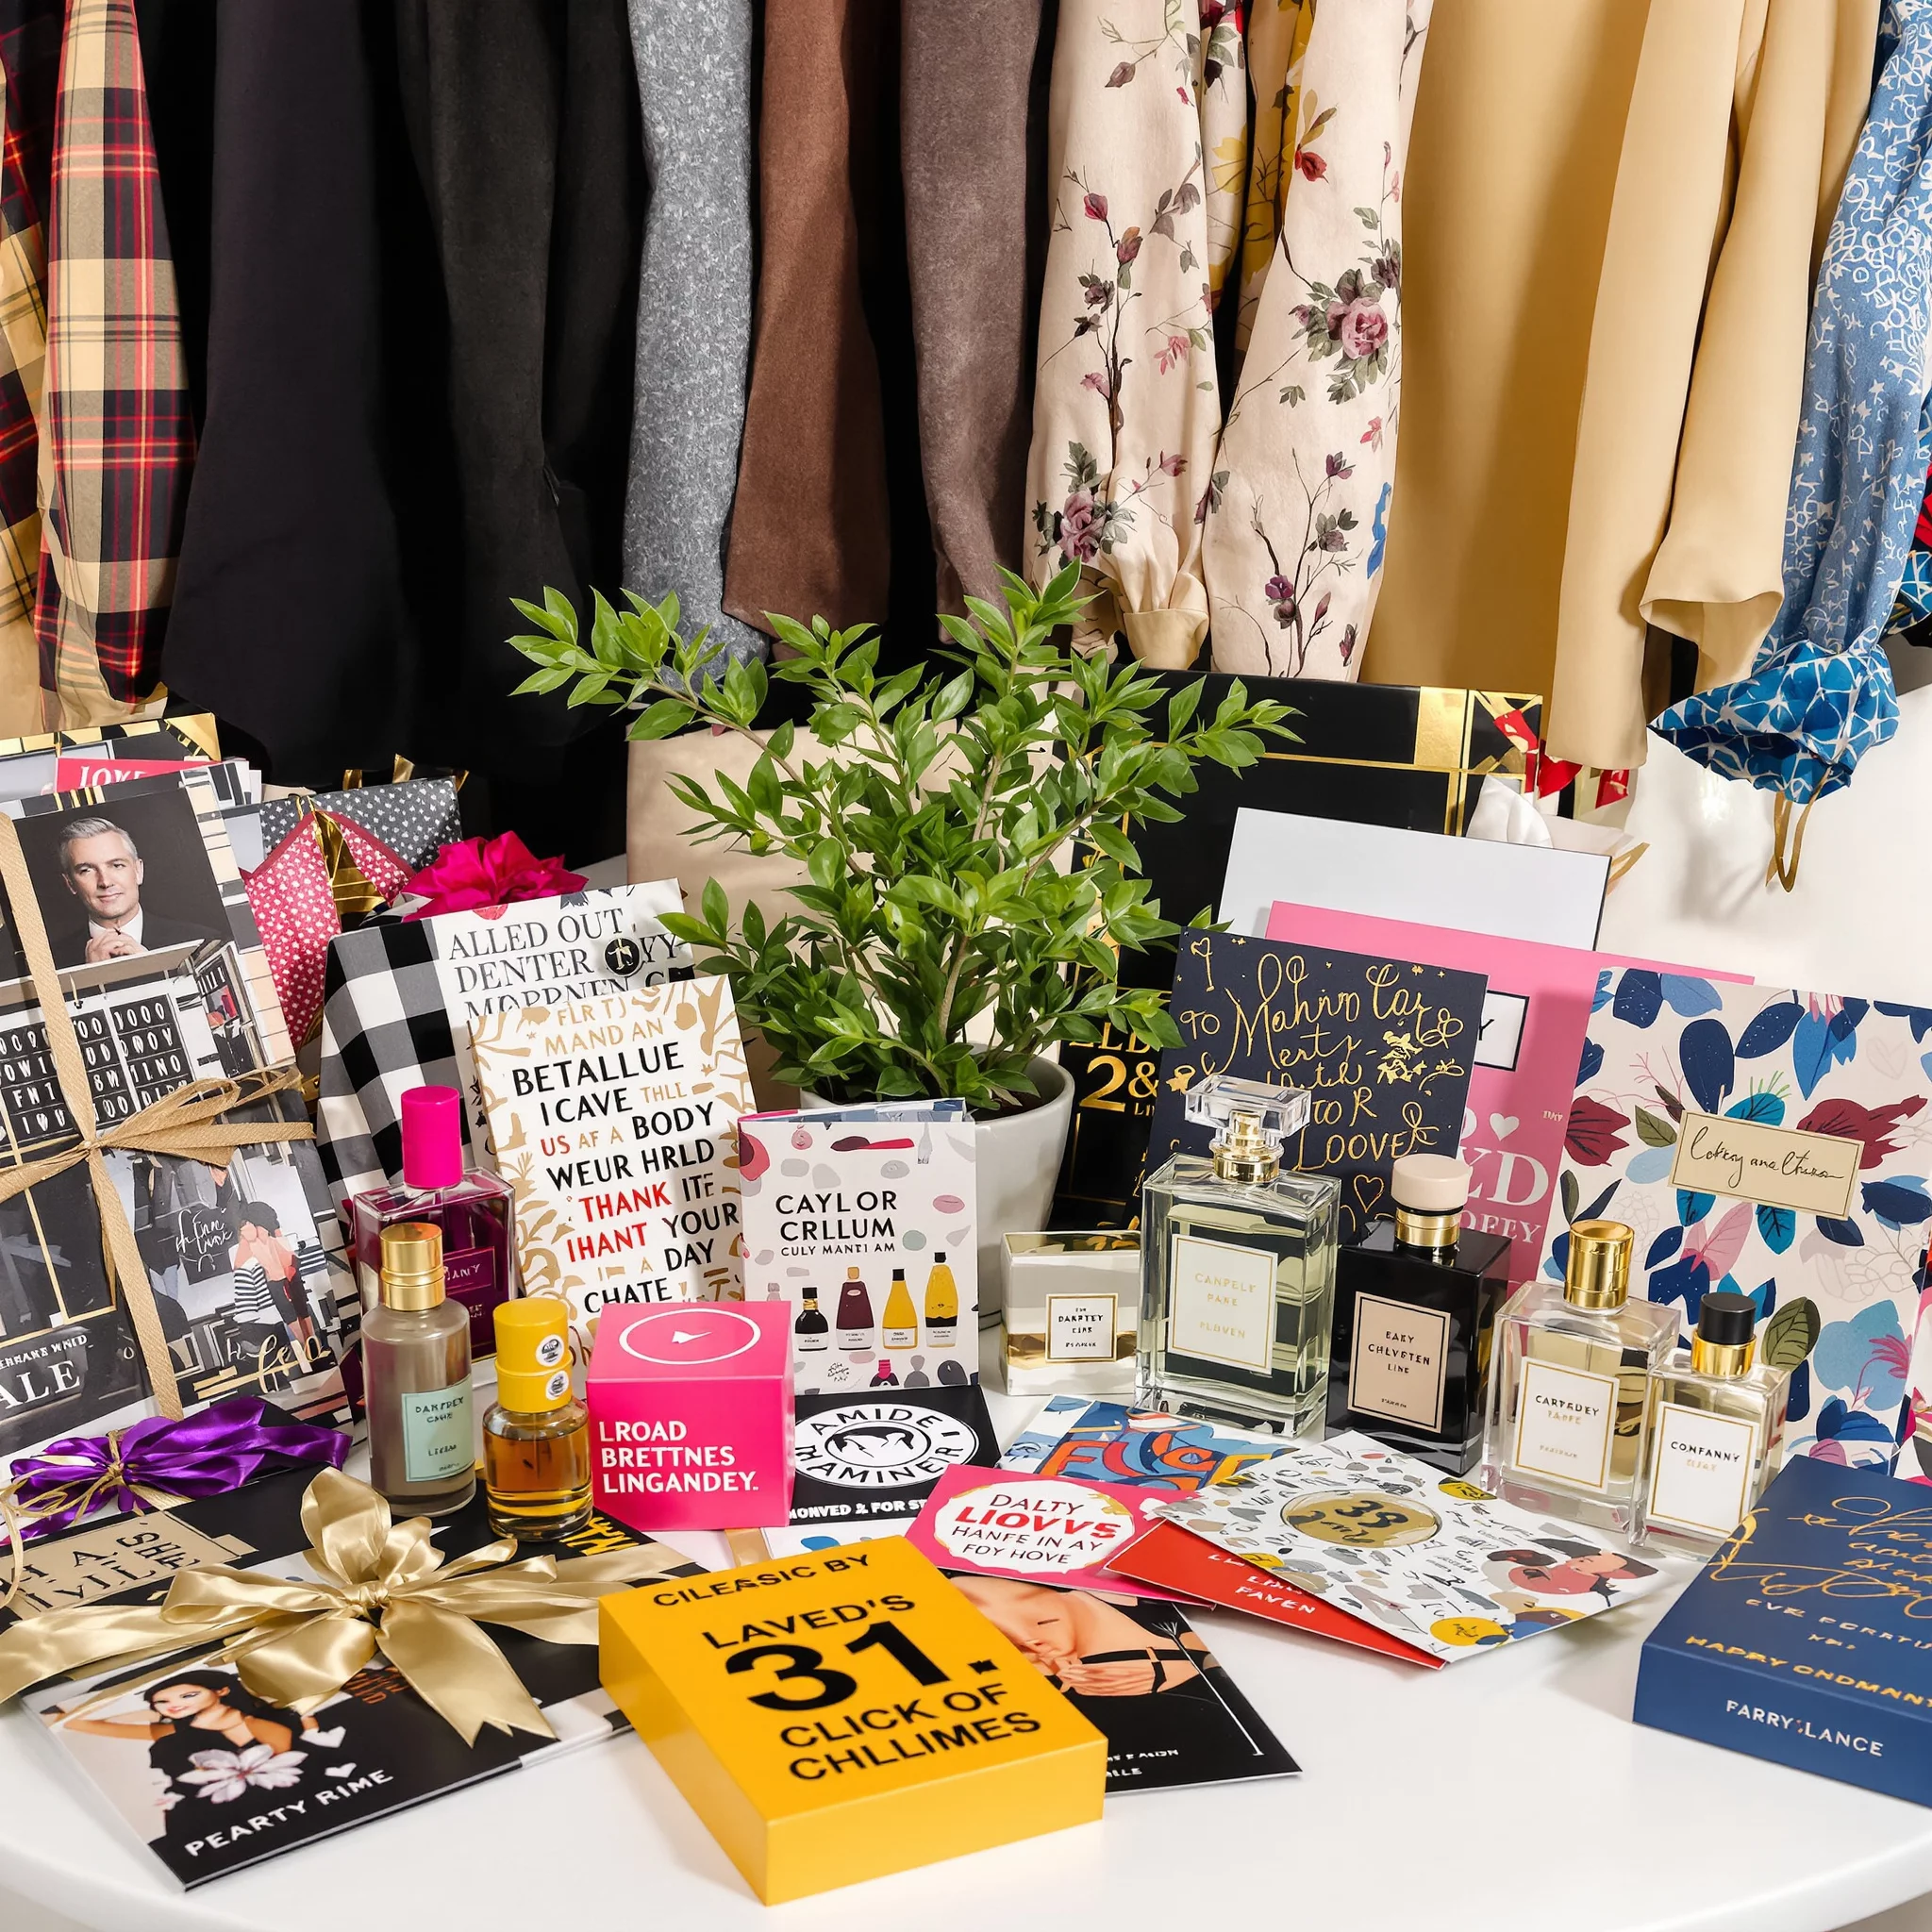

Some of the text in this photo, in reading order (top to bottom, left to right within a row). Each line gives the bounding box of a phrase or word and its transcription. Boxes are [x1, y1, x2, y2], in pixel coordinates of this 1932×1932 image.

[449, 908, 624, 960] ALLED OUT
[454, 948, 595, 993] DENTER
[632, 1017, 664, 1042] AN
[512, 1041, 685, 1097] BETALLUE
[631, 1101, 714, 1141] BODY
[545, 1138, 715, 1192] WEUR HRLD
[578, 1181, 673, 1223] THANK
[775, 1191, 897, 1215] CAYLOR
[661, 1202, 741, 1239] YOUR
[780, 1217, 896, 1241] CRLLUM
[663, 1238, 715, 1272] DAY
[874, 1242, 896, 1253] AM
[599, 1420, 688, 1442] LROAD
[601, 1446, 736, 1468] BRETTNES
[990, 1493, 1085, 1516] DALTY
[1037, 1536, 1064, 1549] IN
[824, 1554, 870, 1573] BY
[1009, 1550, 1073, 1565] HOVE
[780, 1683, 1008, 1748] CLICK OF
[184, 1769, 394, 1857] PEARTY RIME
